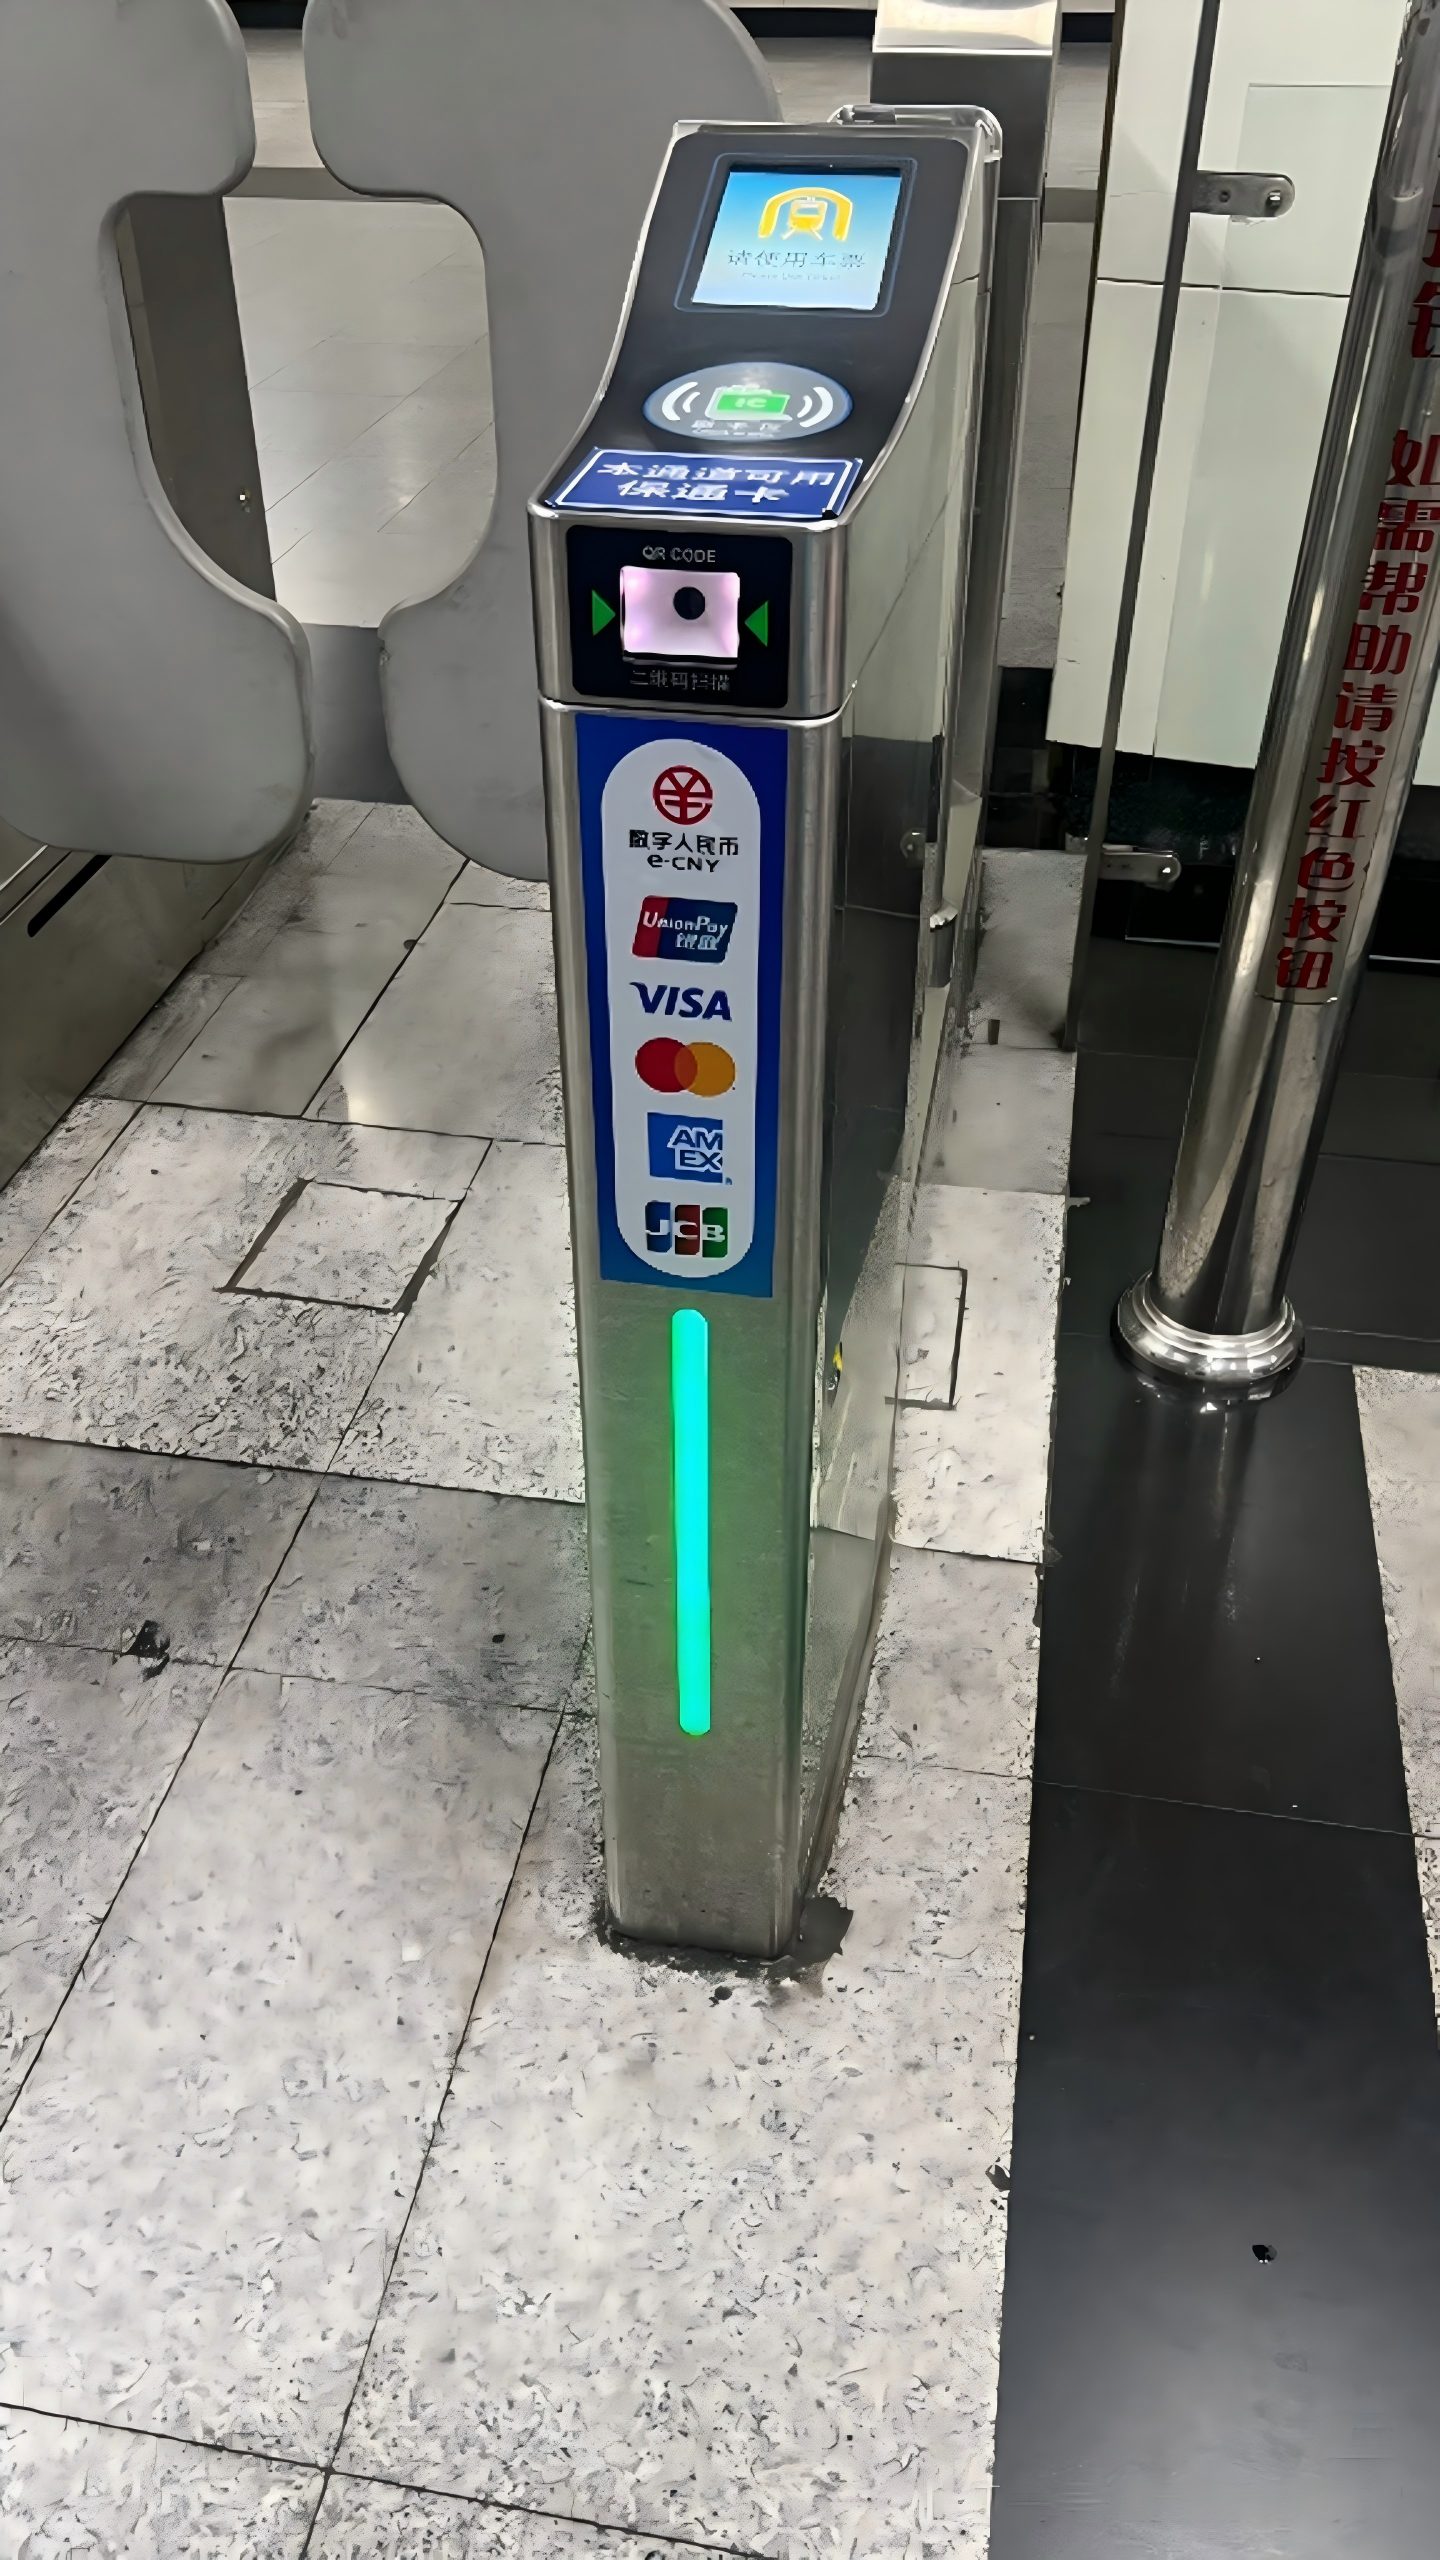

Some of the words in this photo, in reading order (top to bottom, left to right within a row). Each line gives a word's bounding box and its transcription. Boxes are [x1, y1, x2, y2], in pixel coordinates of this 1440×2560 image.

[597, 462, 836, 487] 本通道可用
[617, 479, 790, 504] 保通卡
[642, 545, 666, 561] QR
[669, 547, 717, 563] CODE
[629, 669, 731, 691] 二维码扫描
[628, 829, 739, 857] 数字人民币
[647, 853, 720, 873] e-CNY
[642, 910, 728, 938] UnionPay
[628, 981, 733, 1023] VISA
